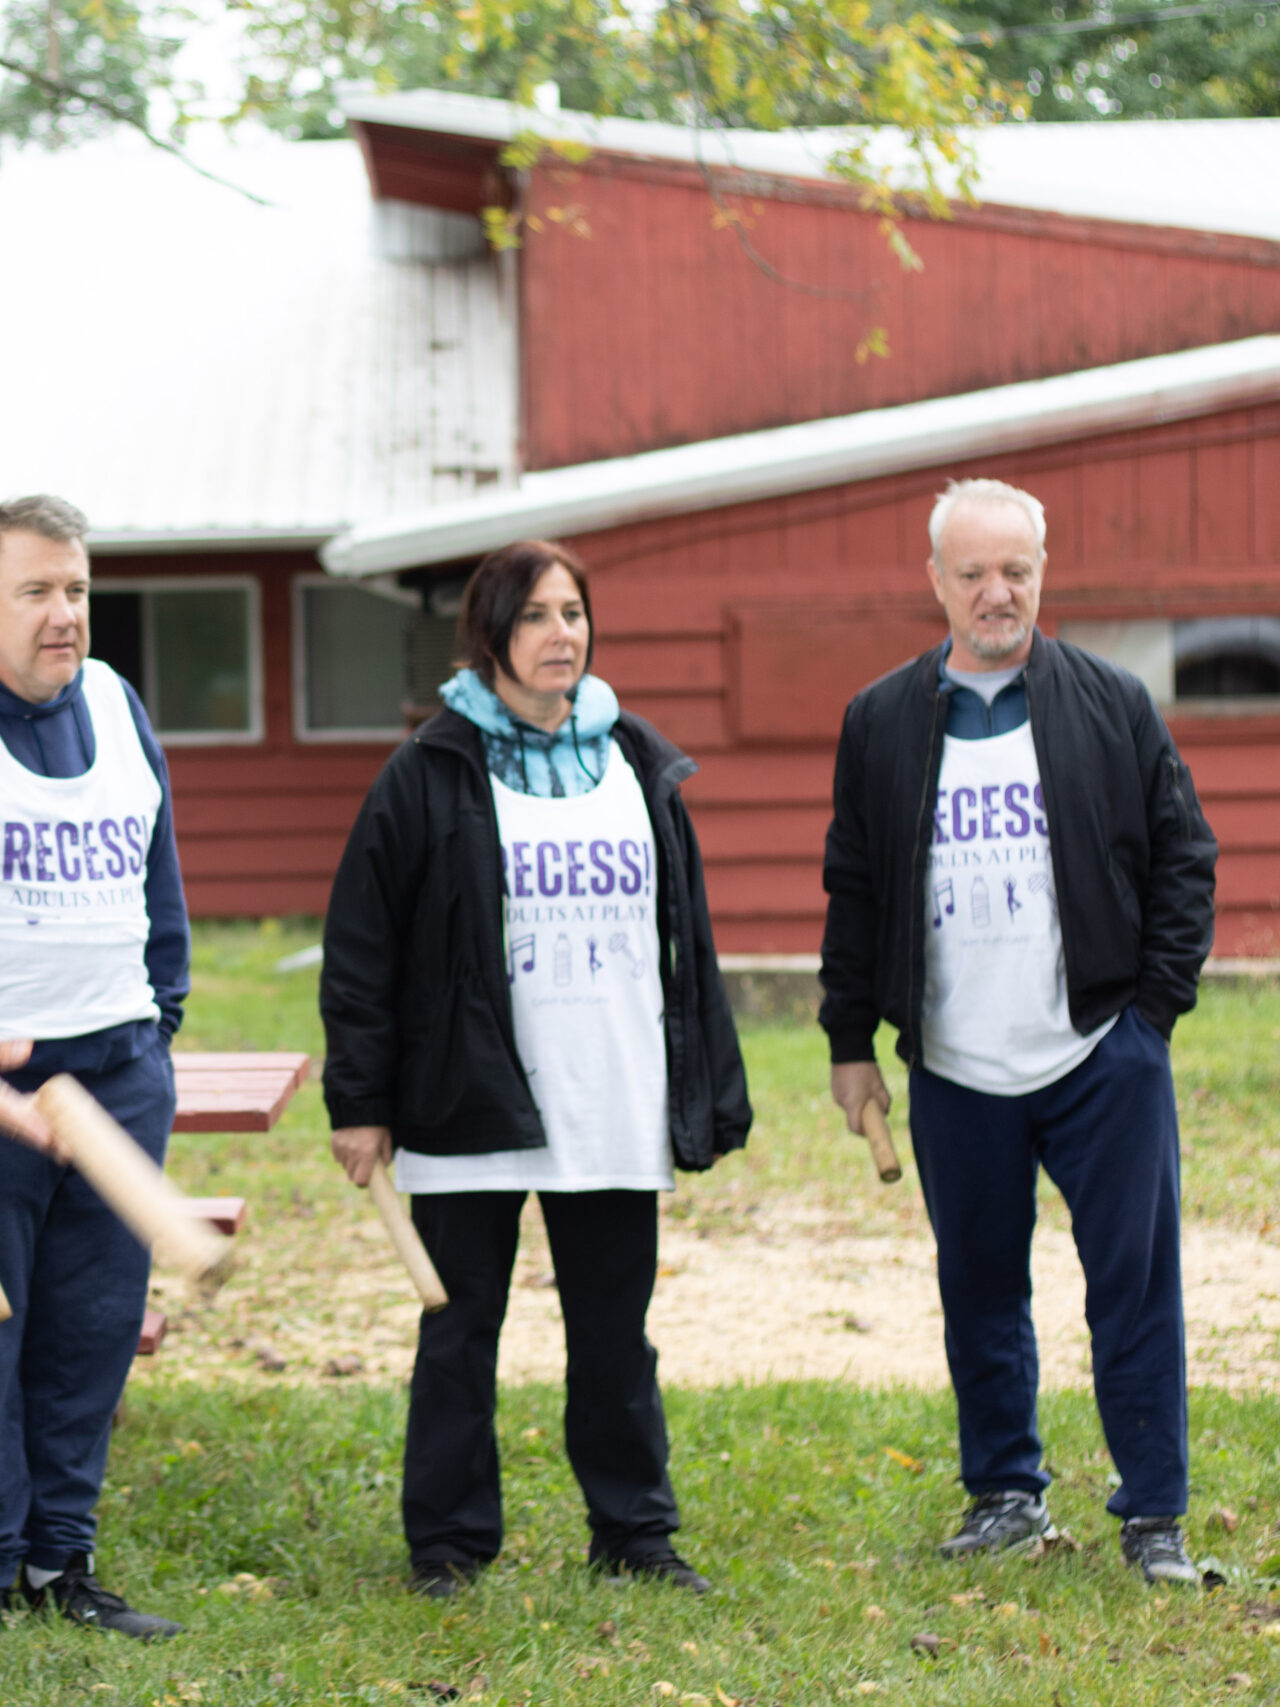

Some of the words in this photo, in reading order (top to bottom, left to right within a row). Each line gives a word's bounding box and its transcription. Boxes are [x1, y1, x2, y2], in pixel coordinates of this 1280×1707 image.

[933, 782, 1049, 845] ECESS
[501, 839, 649, 897] ECESS!
[9, 889, 91, 907] ADULTS
[506, 905, 566, 923] DULTS
[573, 904, 597, 921] AT
[602, 904, 648, 922] PLAY
